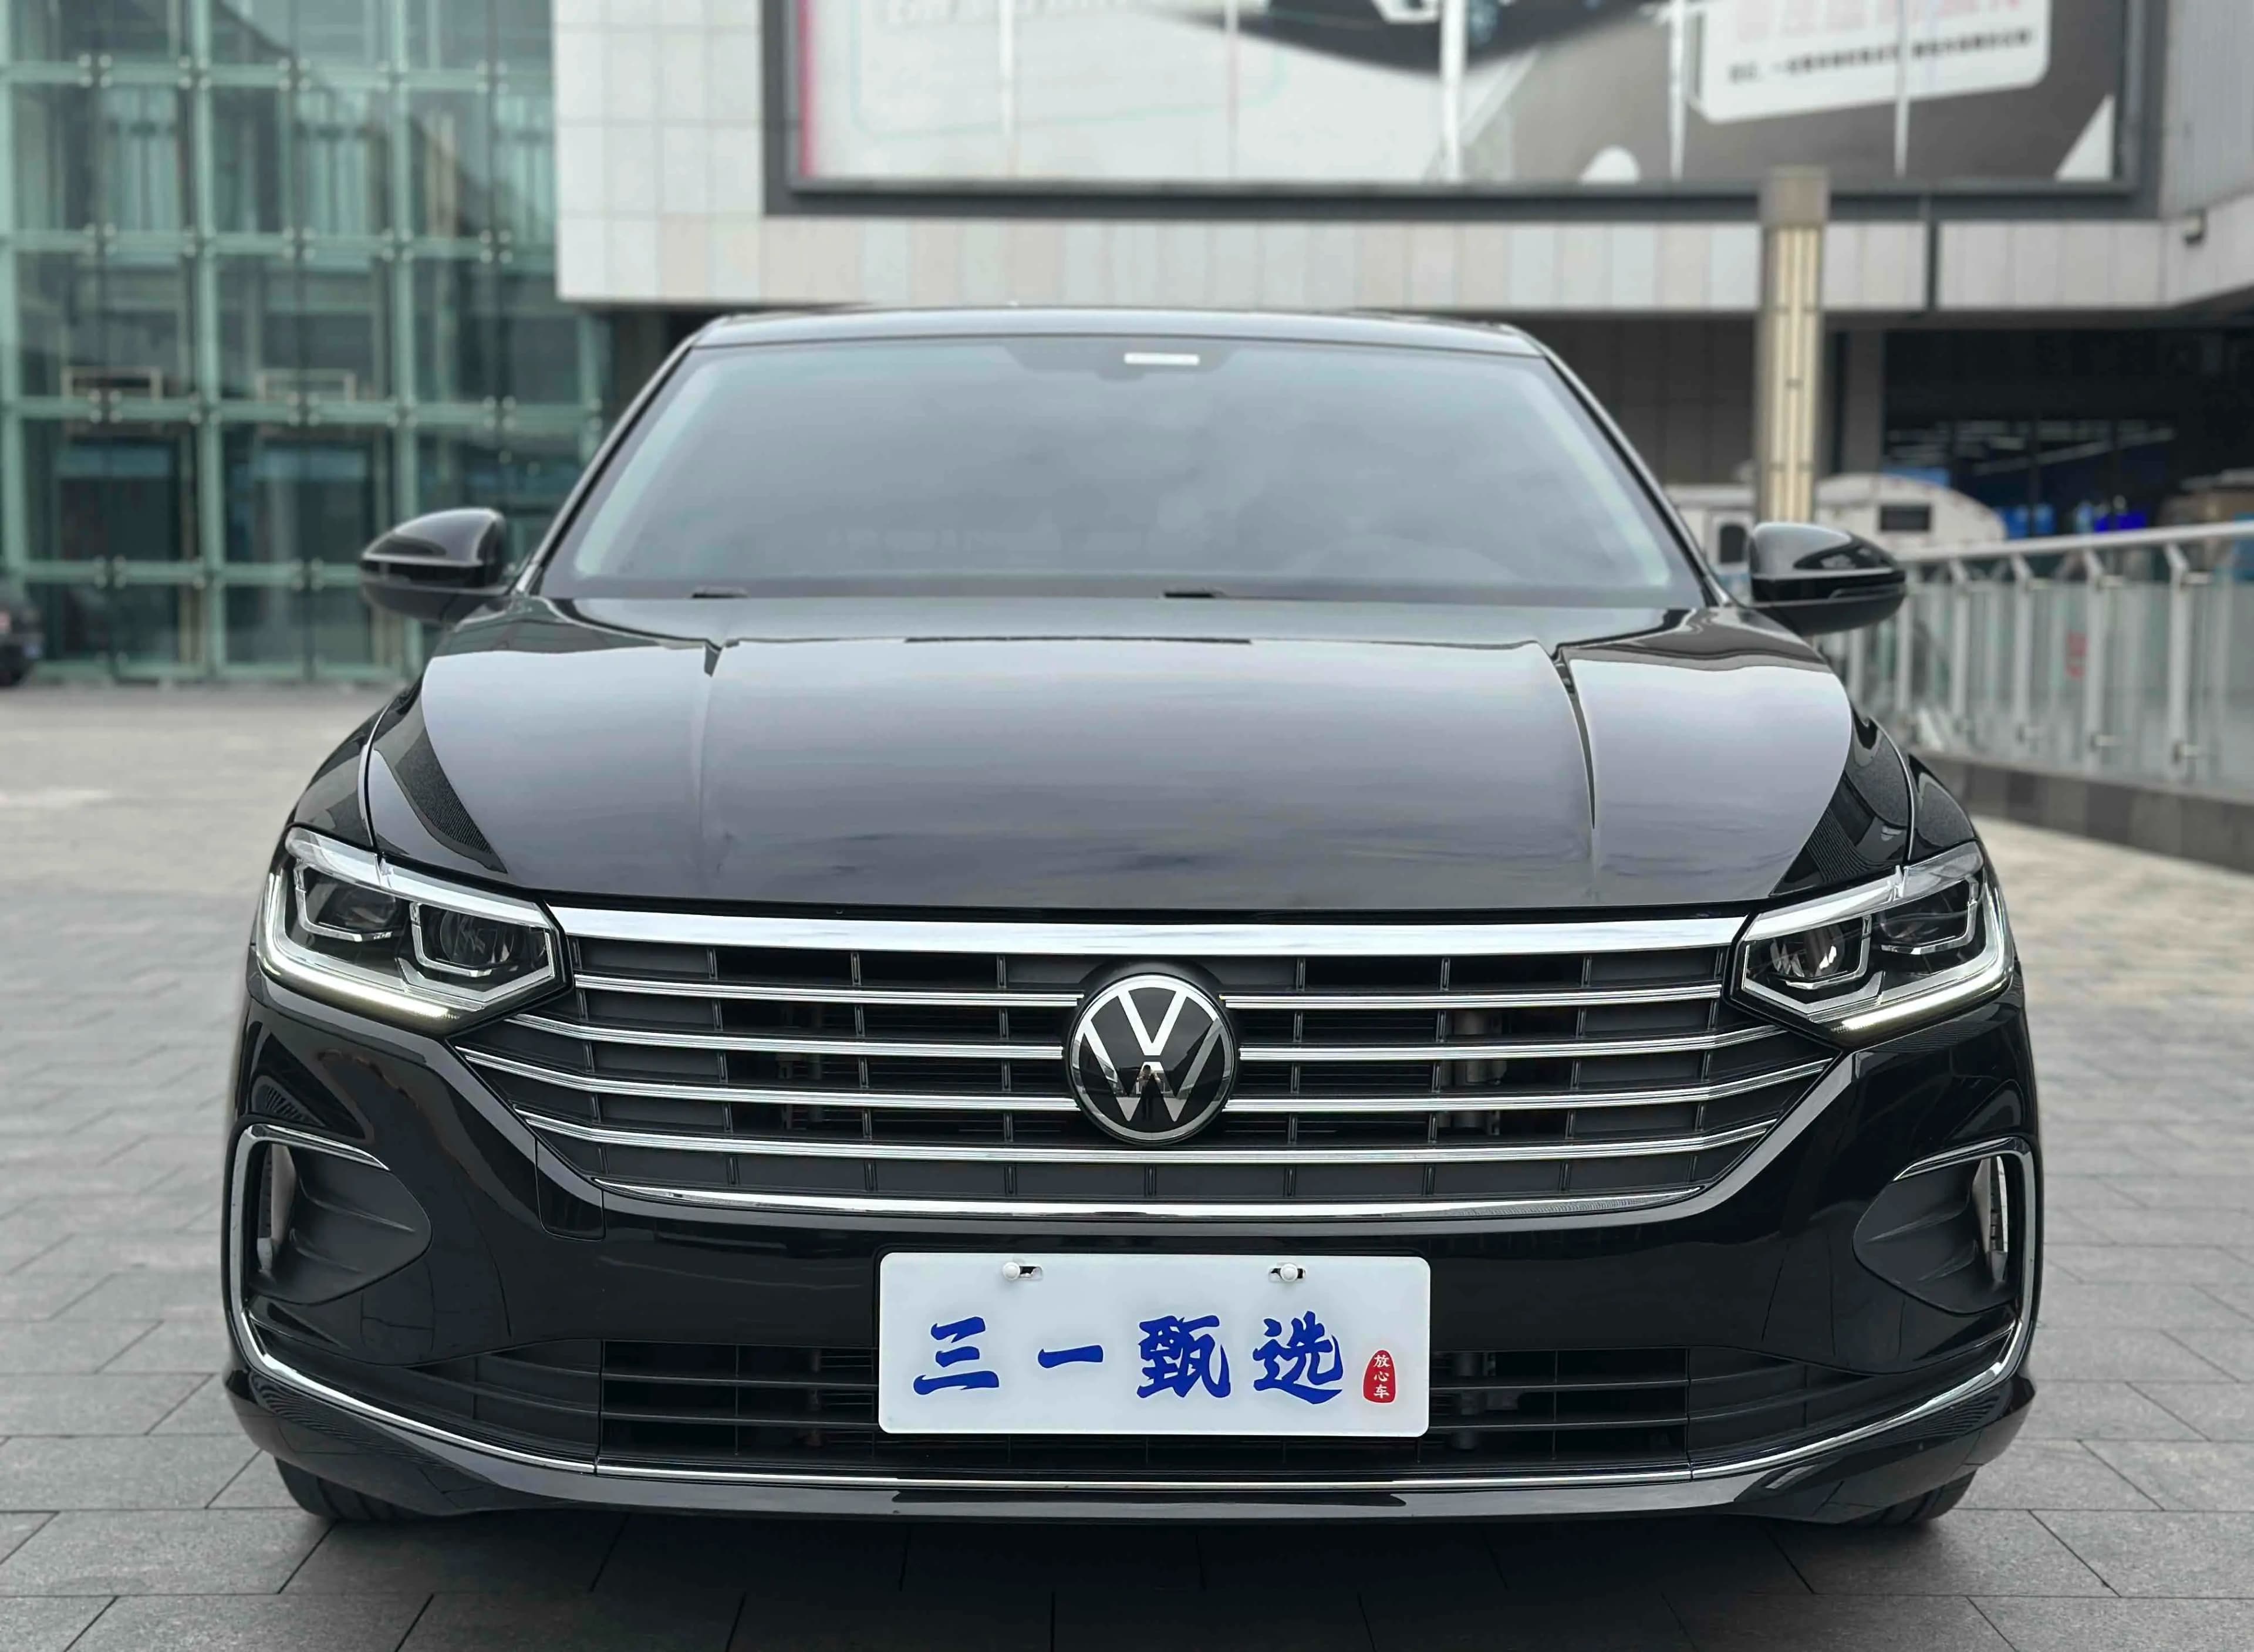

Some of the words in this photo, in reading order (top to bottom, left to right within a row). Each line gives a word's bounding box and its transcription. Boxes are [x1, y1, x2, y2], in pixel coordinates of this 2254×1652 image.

[914, 1312, 1342, 1404] 三一甄选
[1374, 1354, 1390, 1398] 放心车
